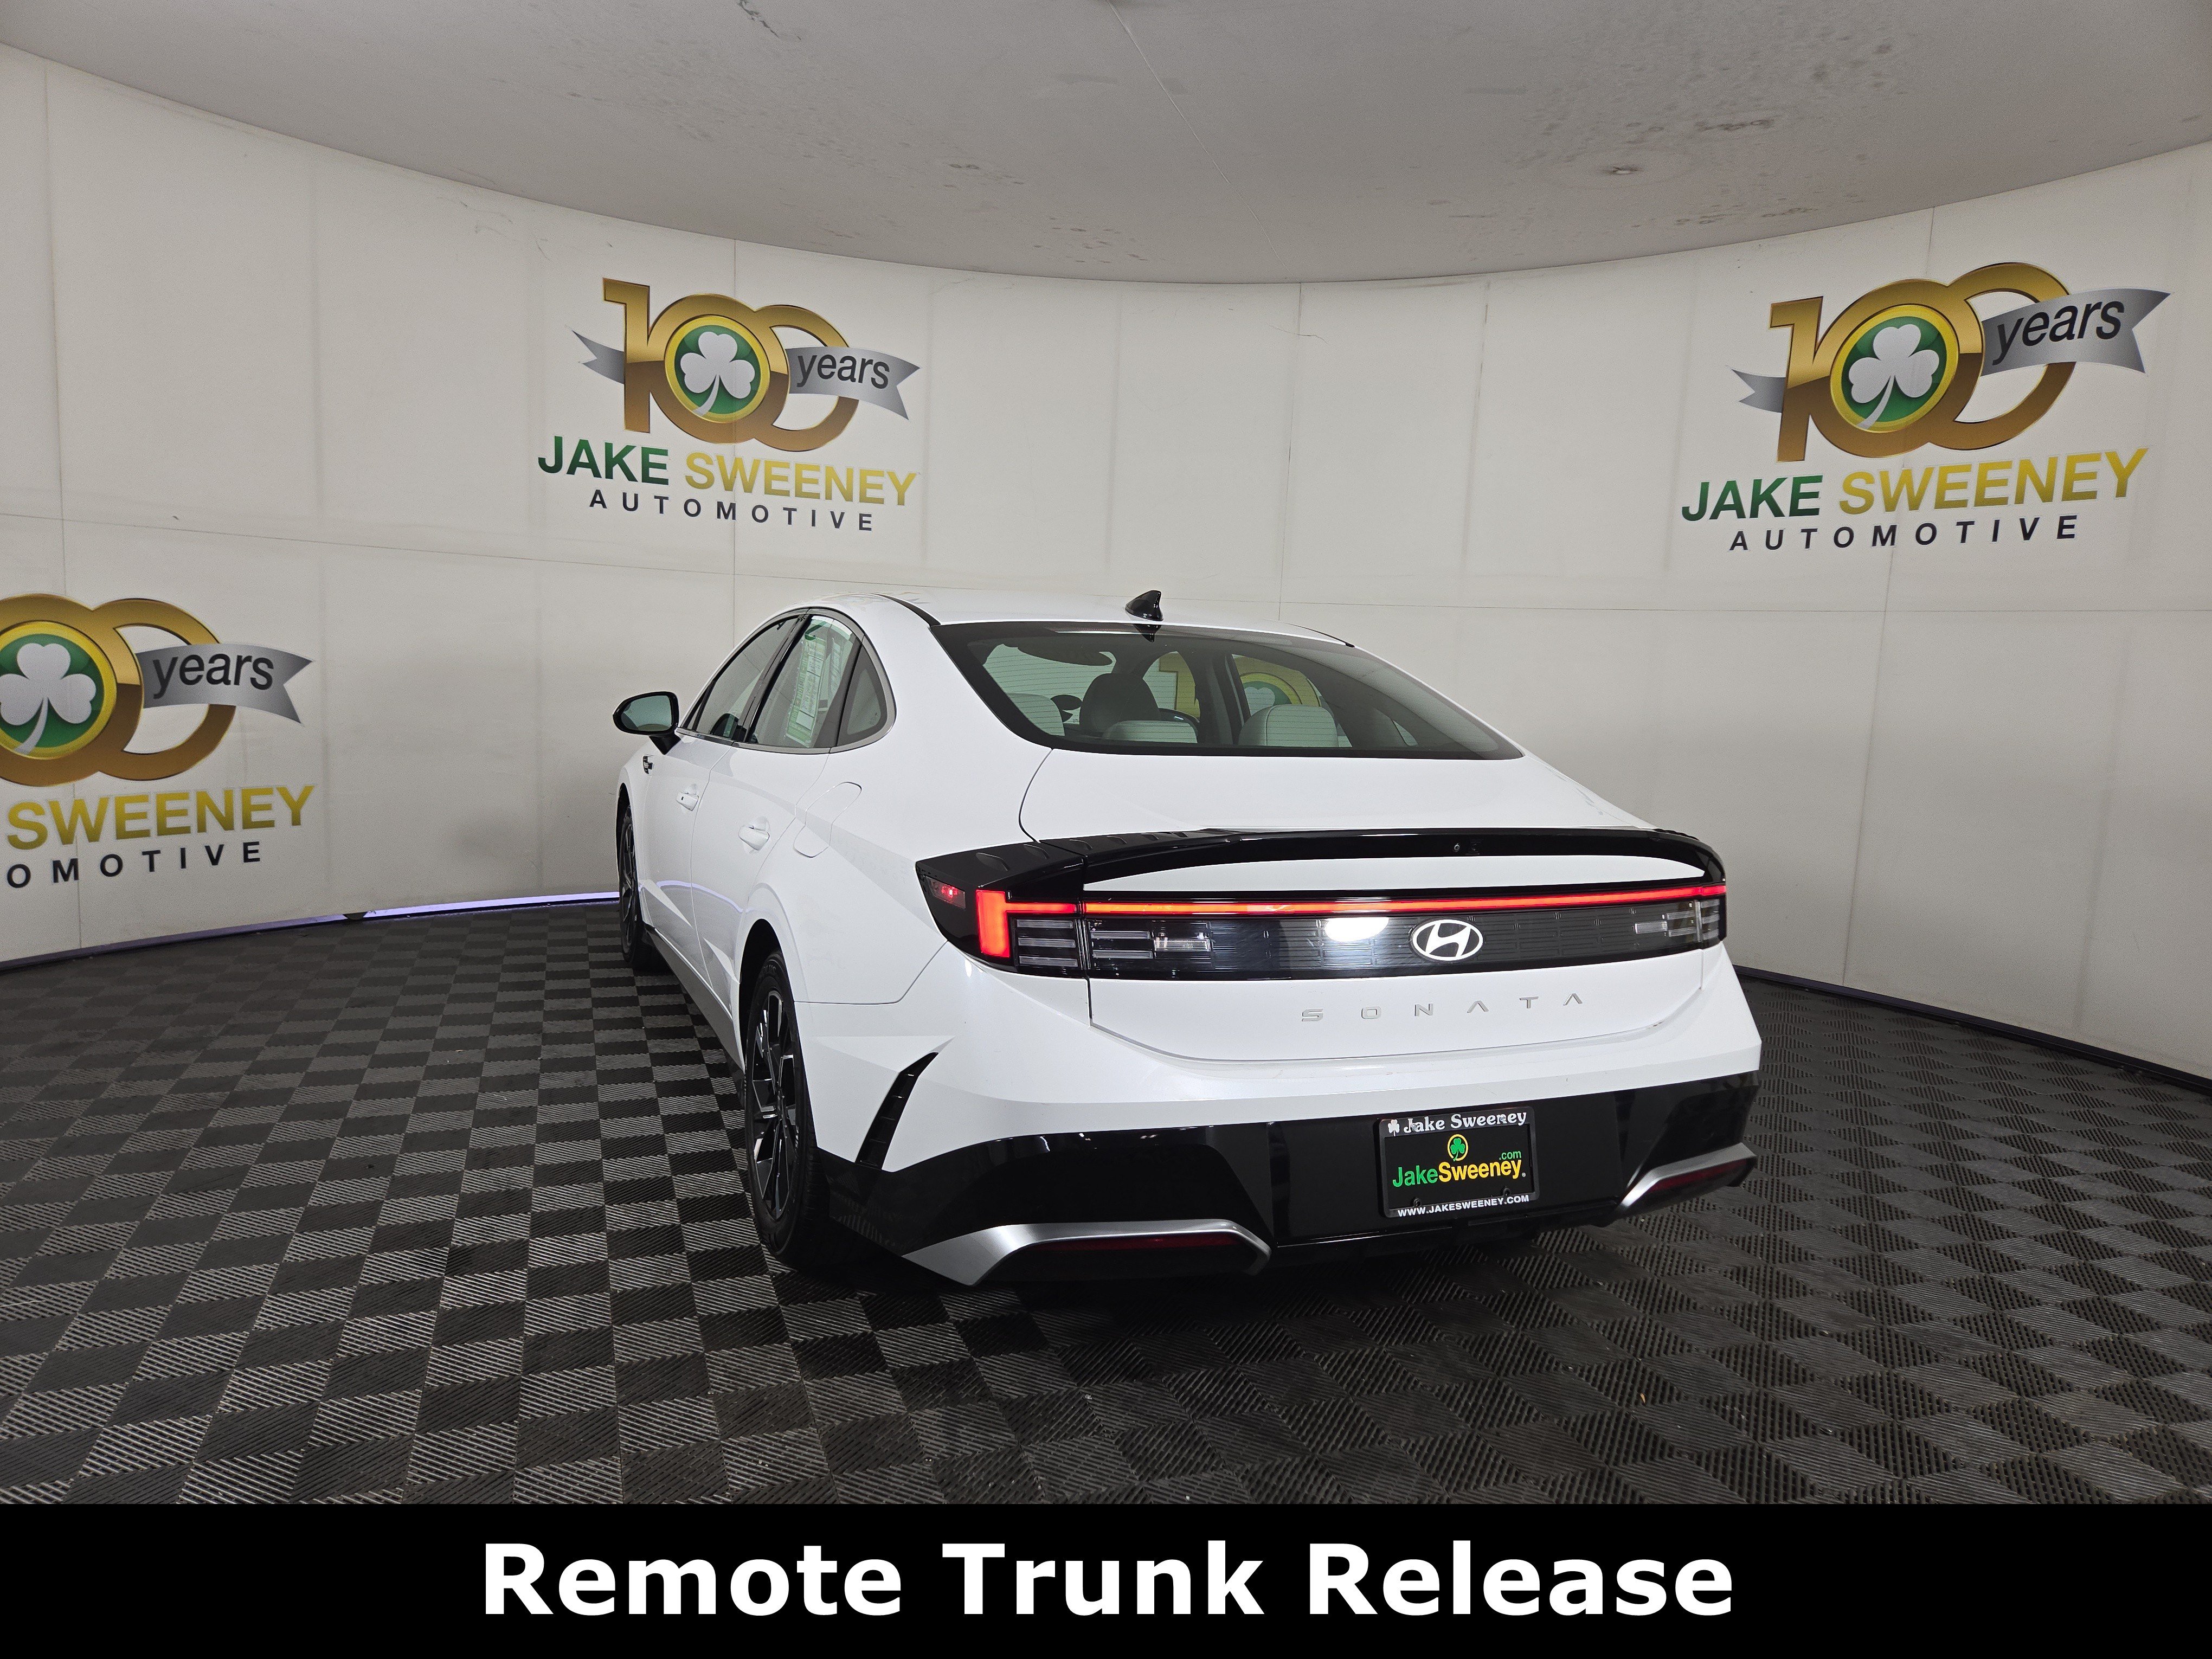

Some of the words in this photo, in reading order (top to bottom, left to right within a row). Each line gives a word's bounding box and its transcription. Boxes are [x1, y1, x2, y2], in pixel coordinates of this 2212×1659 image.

[1991, 300, 2124, 366] years
[796, 351, 891, 390] years
[538, 436, 669, 485] JAKE
[685, 452, 917, 506] SWEENEY
[1681, 474, 1823, 522] JAKE
[1839, 448, 2149, 515] SWEENEY
[589, 489, 872, 531] AUTOMOTIVE
[1729, 515, 2078, 551] AUTOMOTIVE
[152, 653, 274, 699] years
[7, 786, 315, 850] SWEENEY
[7, 841, 261, 888] OMOTIVE
[1302, 993, 1583, 1022] SONATA
[1404, 1116, 1445, 1133] Jake
[1450, 1112, 1527, 1126] Sweeney
[1499, 1150, 1522, 1161] .com
[1398, 1195, 1529, 1217] WWW.JAKESWEENEY.COM
